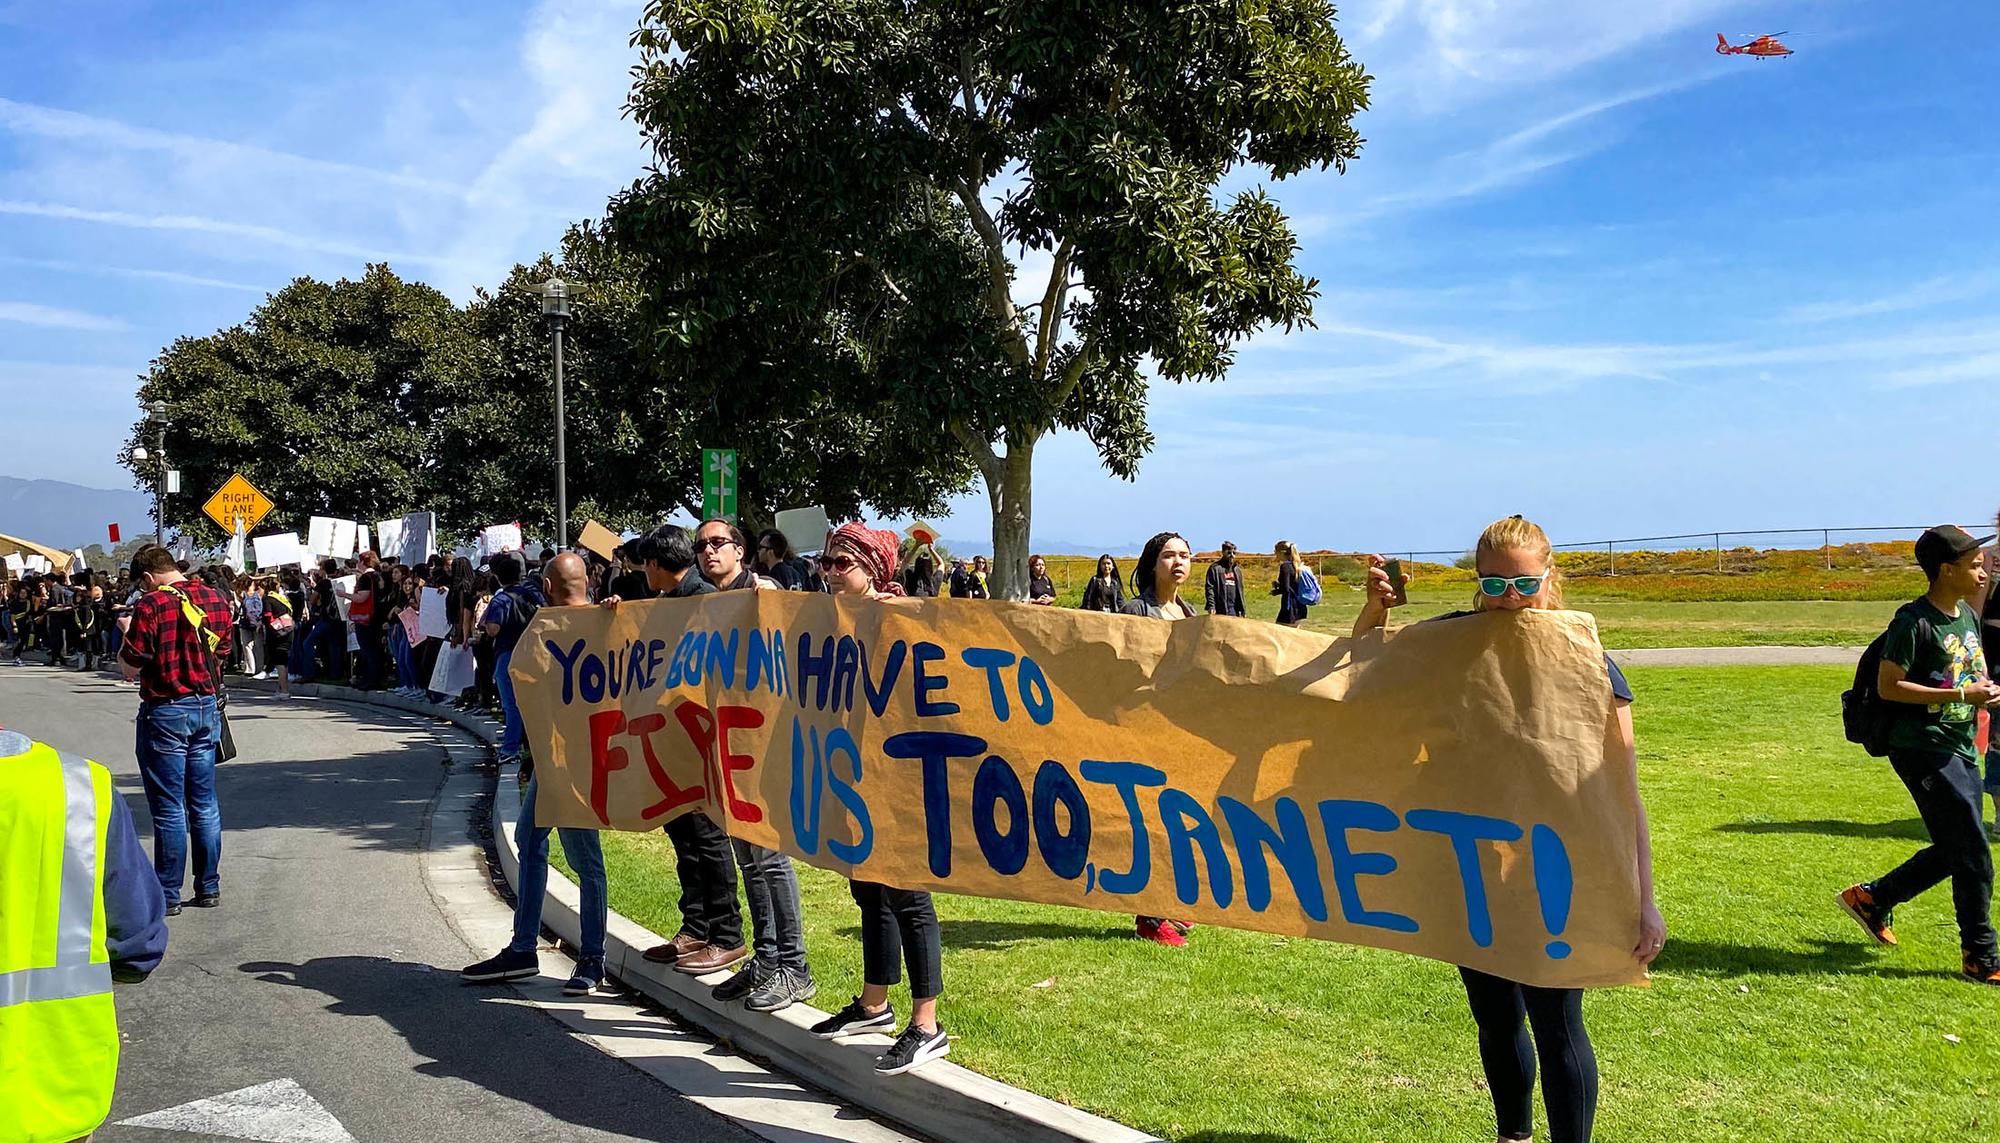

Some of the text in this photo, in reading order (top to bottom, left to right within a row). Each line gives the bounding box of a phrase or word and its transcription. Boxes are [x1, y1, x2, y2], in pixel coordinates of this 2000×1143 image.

[223, 493, 256, 503] RIGHT
[224, 504, 254, 514] LANE
[546, 638, 667, 705] YOU'RE
[797, 632, 960, 718] HAVE
[961, 647, 1054, 726] TO
[589, 701, 765, 826] FIRE
[790, 715, 874, 865] US
[1079, 759, 1574, 960] JANET!
